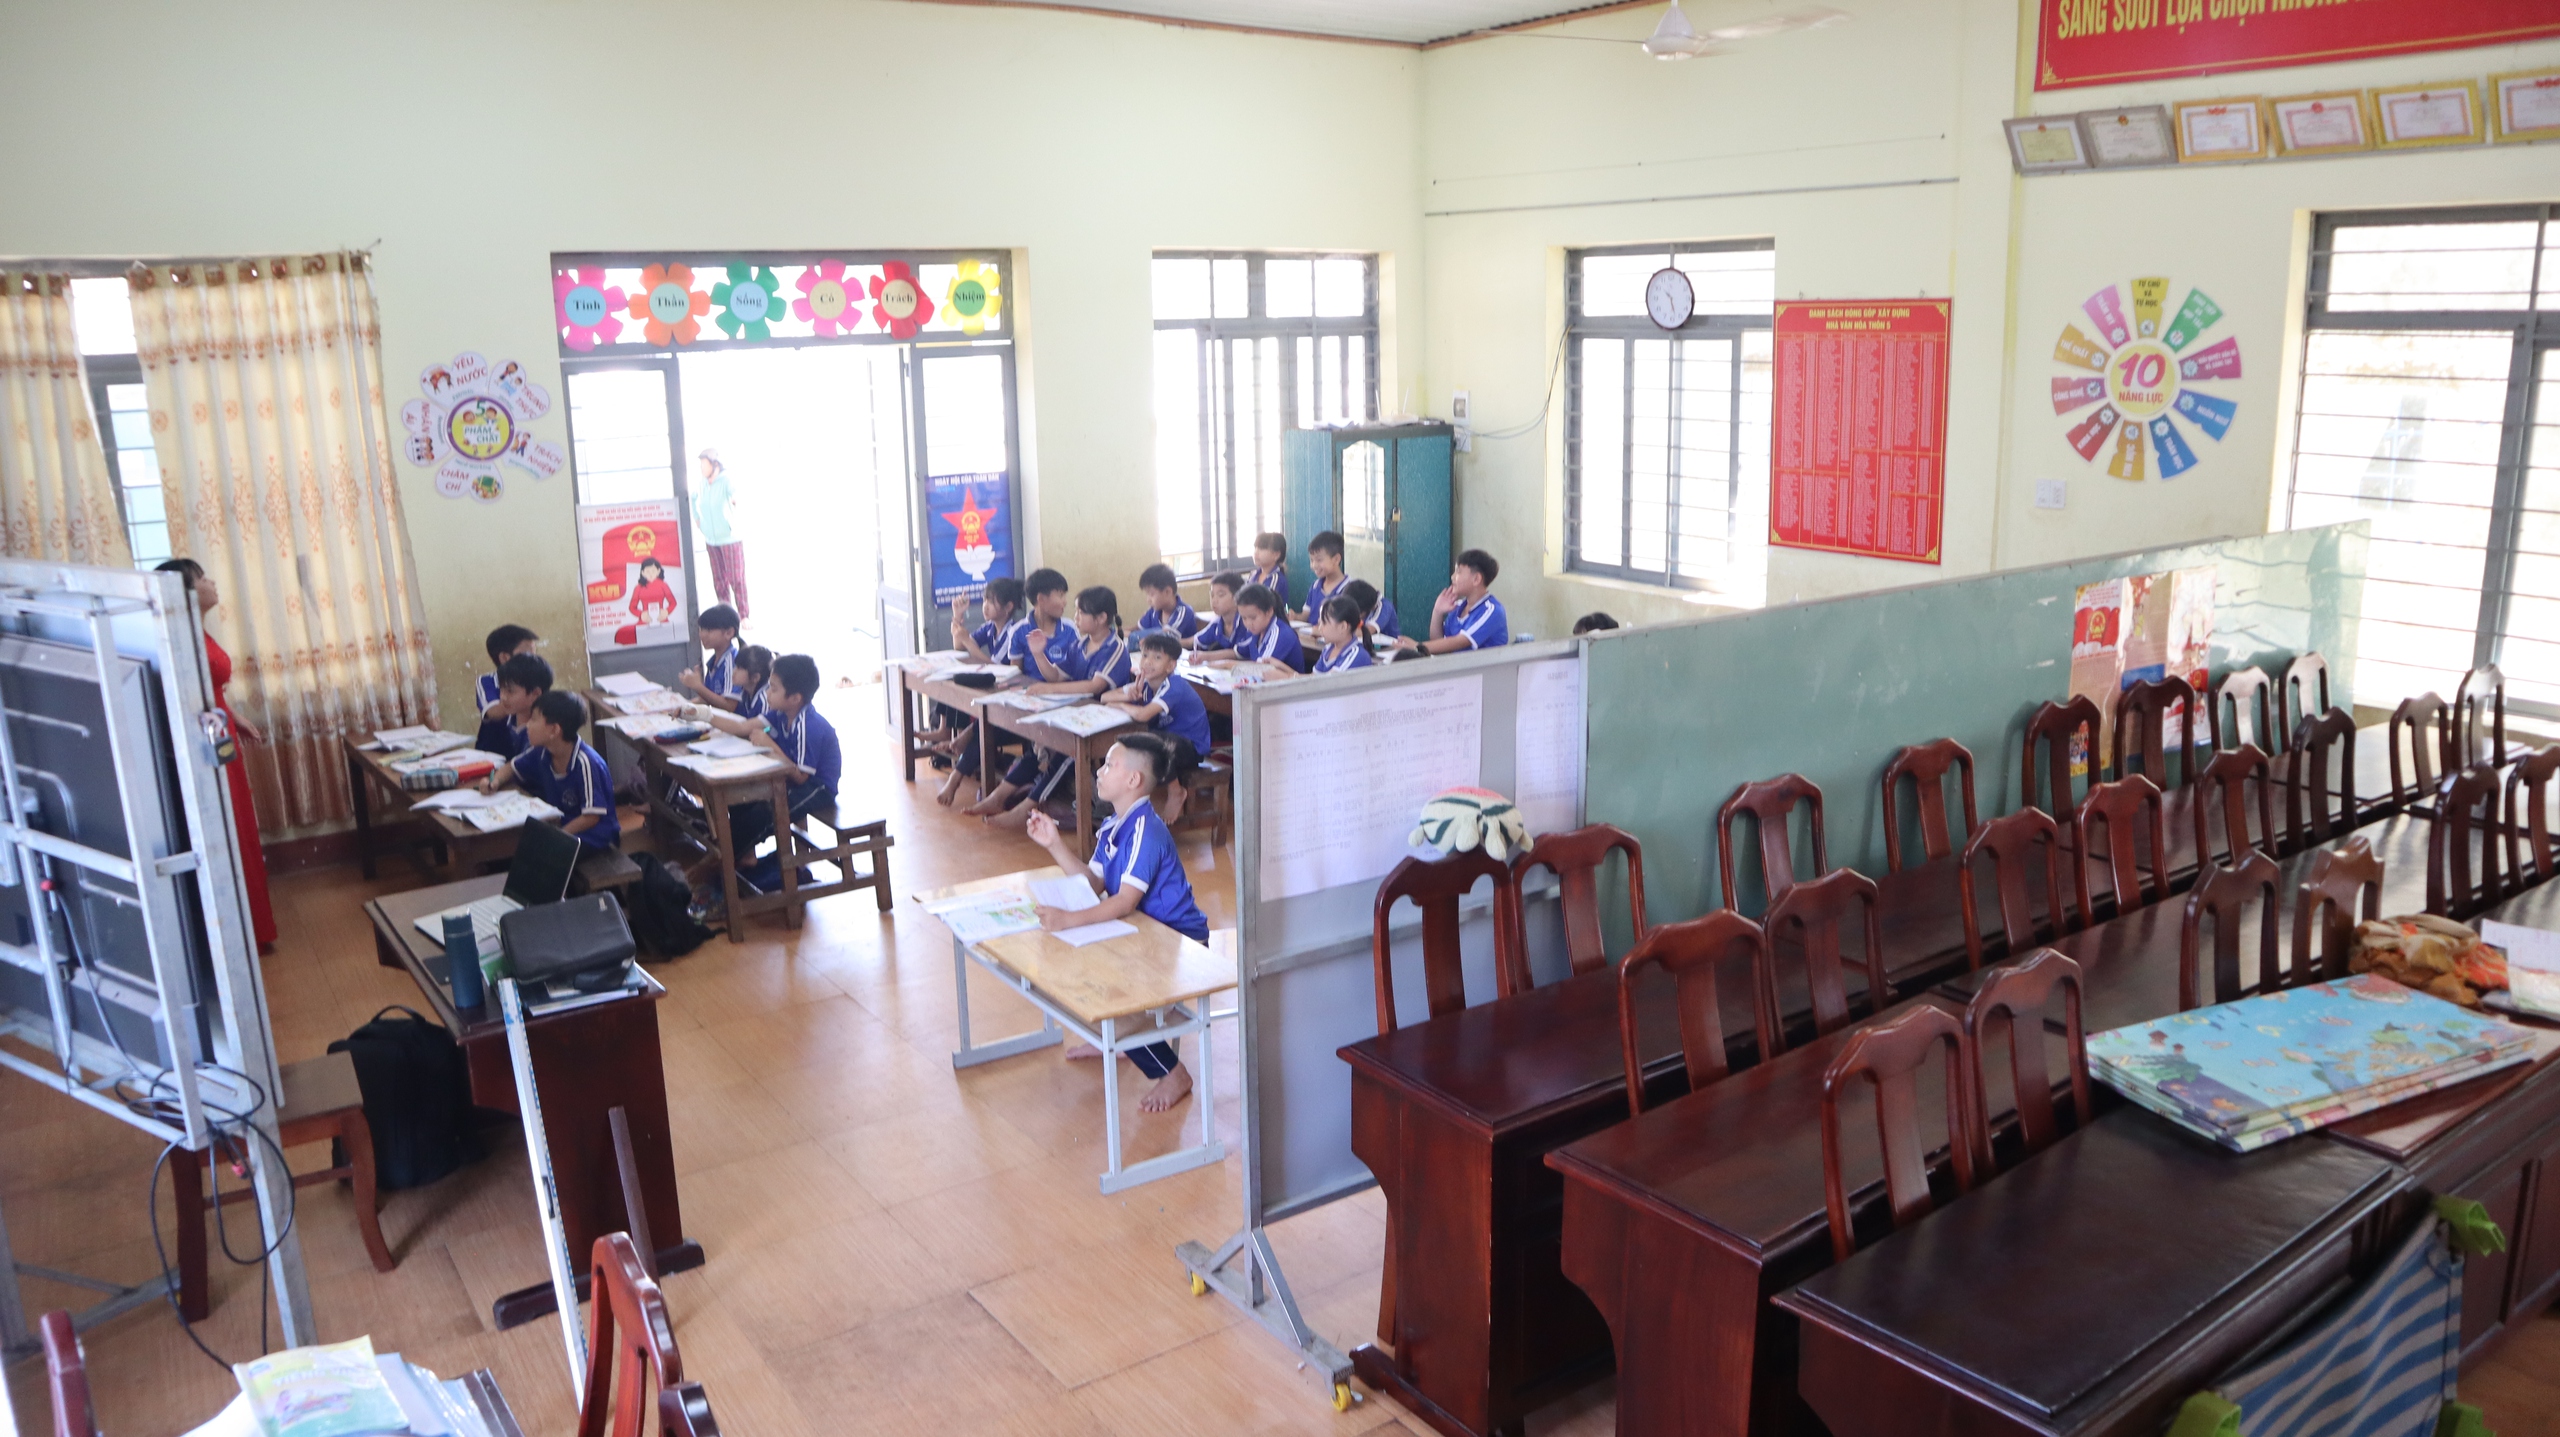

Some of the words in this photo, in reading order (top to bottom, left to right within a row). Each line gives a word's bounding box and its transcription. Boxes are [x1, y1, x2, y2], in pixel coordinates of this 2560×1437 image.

[955, 291, 985, 304] Nhiệm
[456, 366, 487, 386] NƯỚC
[2118, 352, 2166, 388] 10
[2119, 391, 2143, 403] NĂNG
[2146, 392, 2164, 405] LỰC
[475, 399, 486, 417] 5
